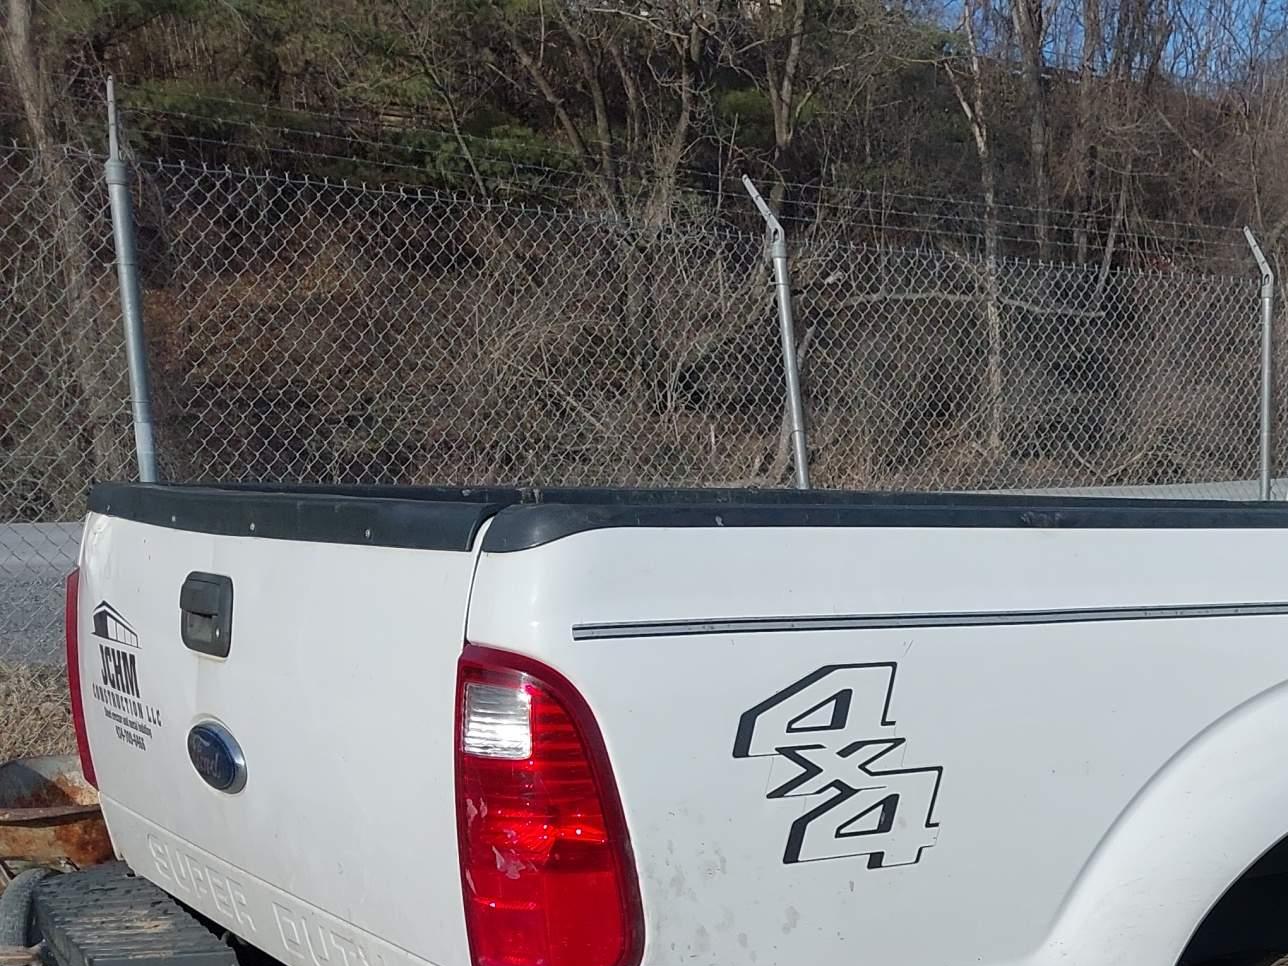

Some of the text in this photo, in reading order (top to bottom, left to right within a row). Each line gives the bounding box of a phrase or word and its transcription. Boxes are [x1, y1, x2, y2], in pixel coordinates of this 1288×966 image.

[98, 643, 140, 699] JCHM
[146, 704, 162, 727] LLC
[147, 833, 257, 933] SUPER
